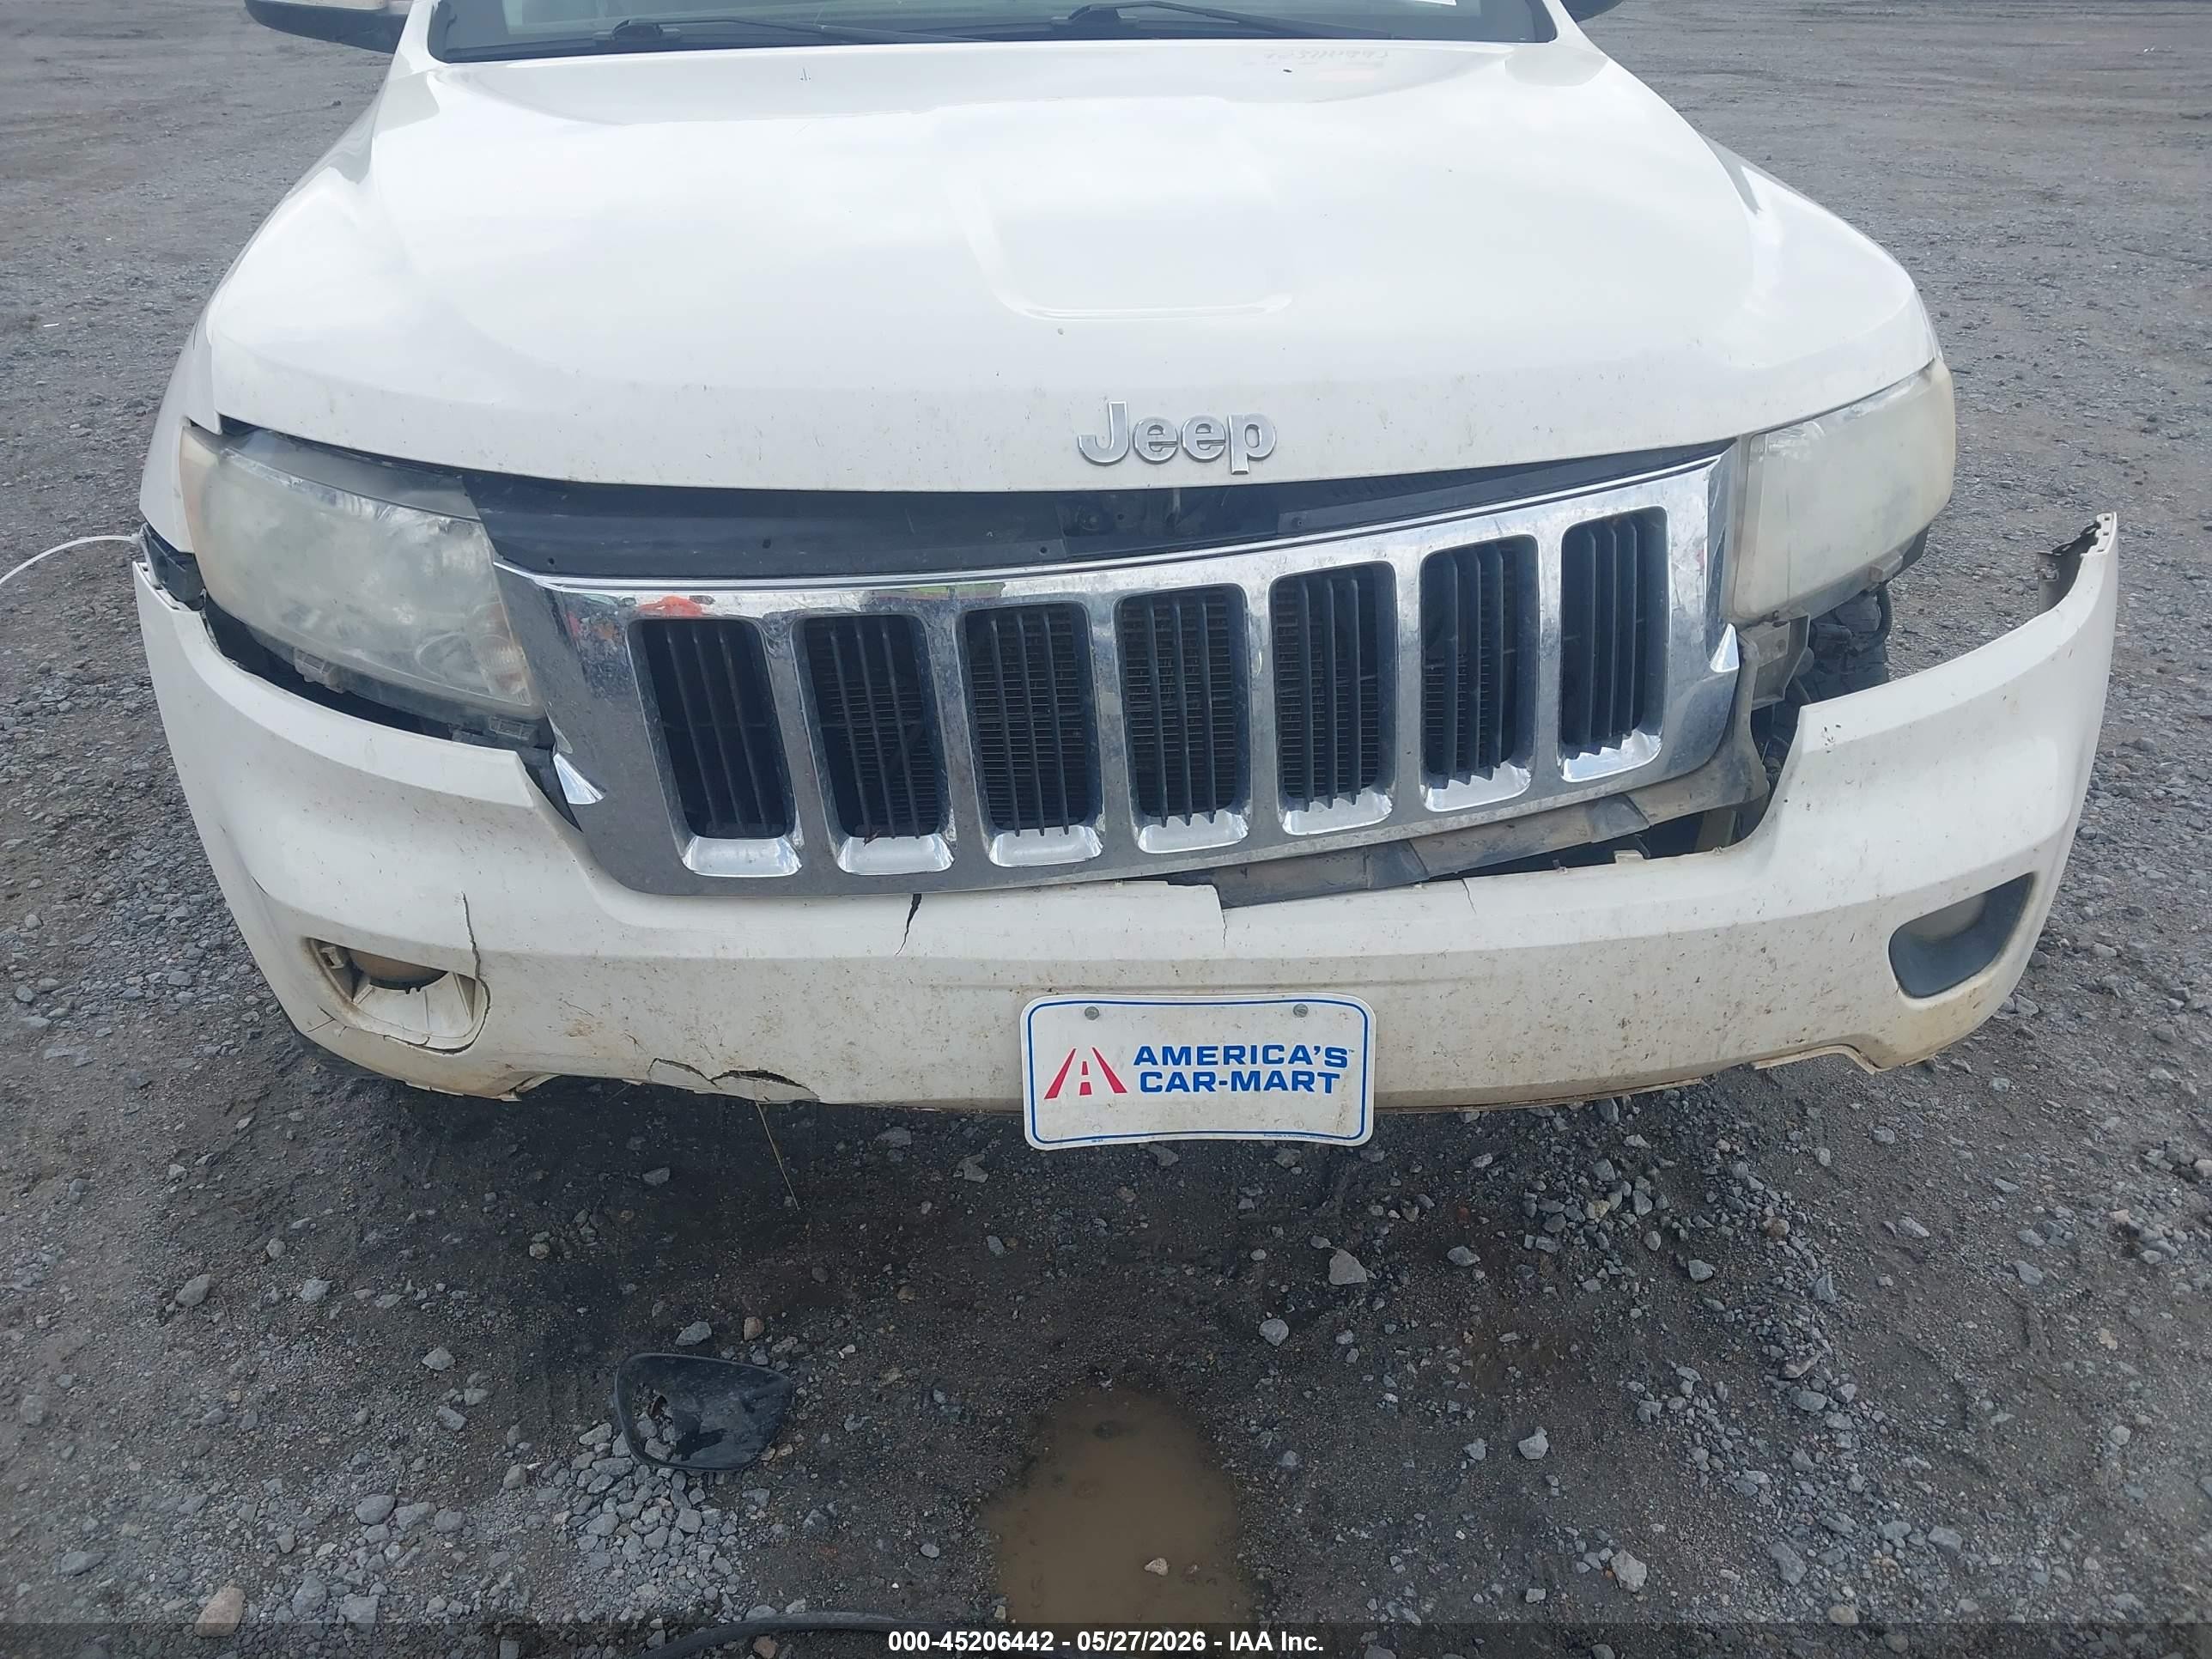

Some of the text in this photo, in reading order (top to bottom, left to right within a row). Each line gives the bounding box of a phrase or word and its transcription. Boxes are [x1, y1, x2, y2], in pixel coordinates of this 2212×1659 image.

[1079, 401, 1277, 475] Jeep
[1133, 1044, 1348, 1068] AMERICA'S
[1139, 1070, 1340, 1094] CAR-MART
